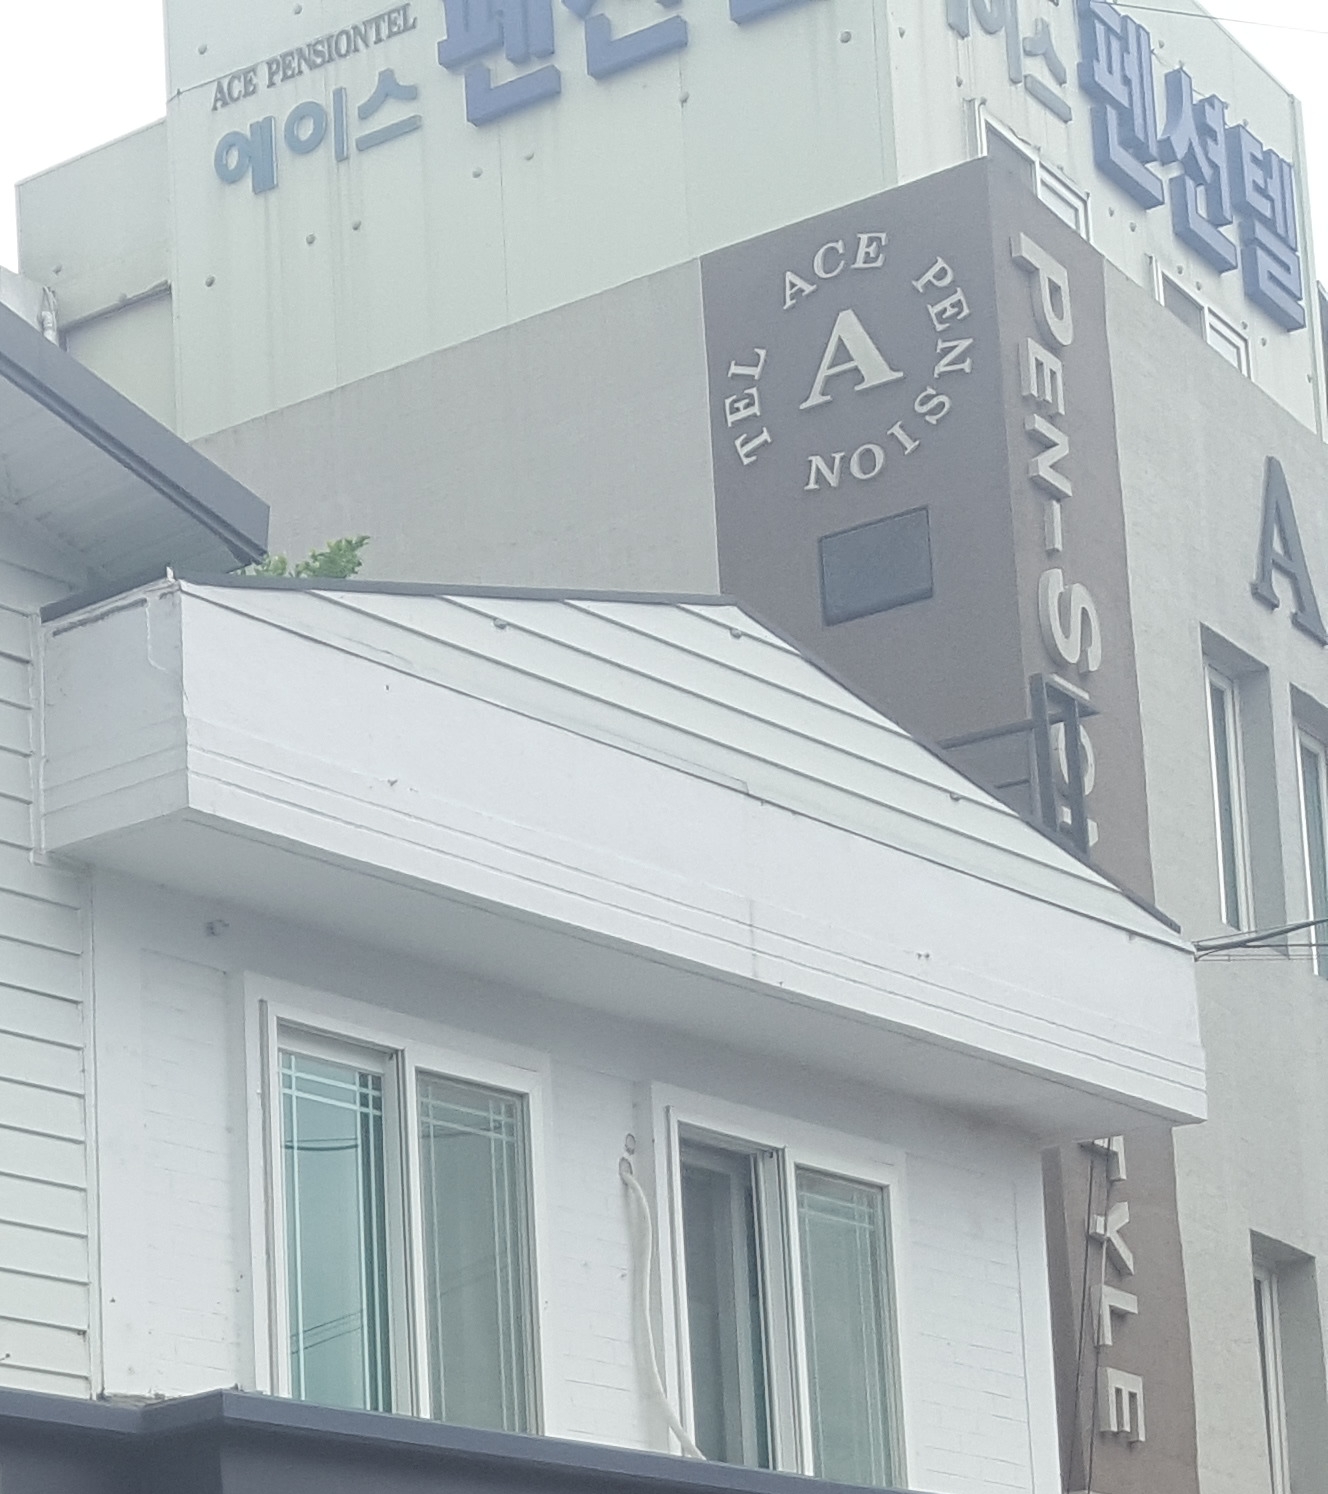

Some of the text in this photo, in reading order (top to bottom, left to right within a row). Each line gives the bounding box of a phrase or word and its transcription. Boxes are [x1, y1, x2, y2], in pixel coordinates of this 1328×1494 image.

[211, 70, 258, 111] ACE
[265, 3, 418, 89] PENSIONTEL
[213, 68, 421, 194] 에이스
[1076, 0, 1307, 332] 펜션텔
[783, 232, 889, 310] ACE
[724, 347, 773, 466] TEL
[798, 308, 904, 410] A
